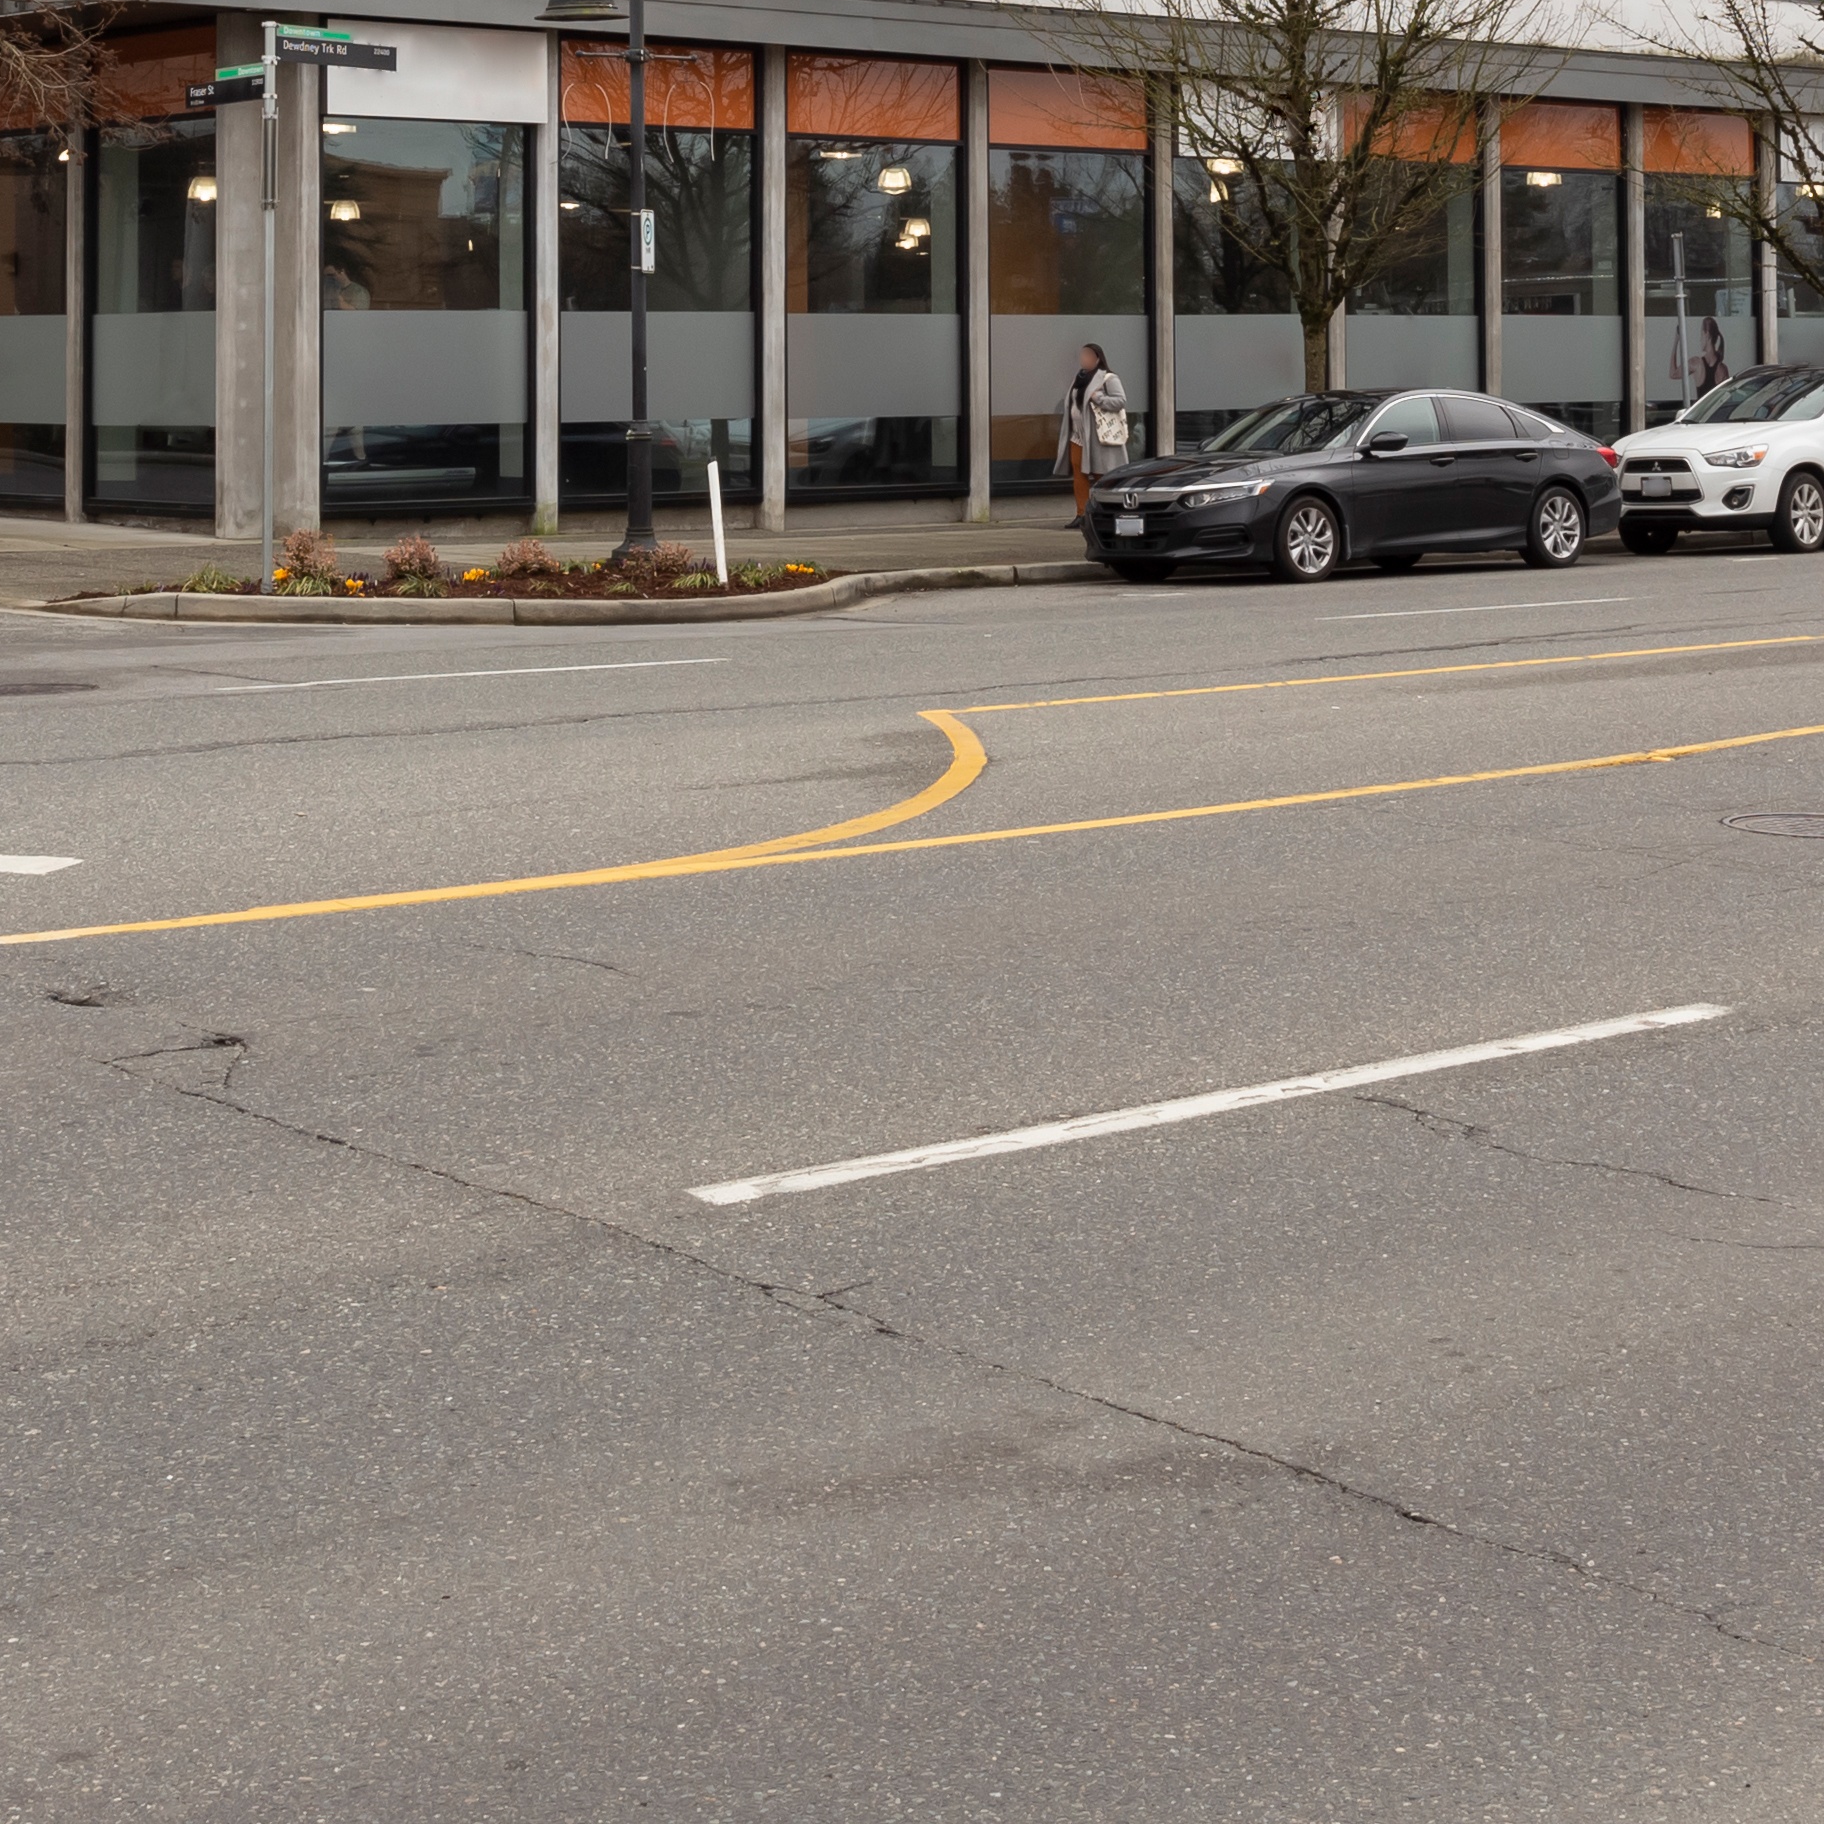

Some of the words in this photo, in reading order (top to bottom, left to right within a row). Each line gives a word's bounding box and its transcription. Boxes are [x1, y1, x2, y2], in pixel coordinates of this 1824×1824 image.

[283, 26, 321, 37] Downtown
[283, 40, 320, 54] Dewdney
[321, 43, 334, 54] Trk
[336, 45, 347, 55] Rd
